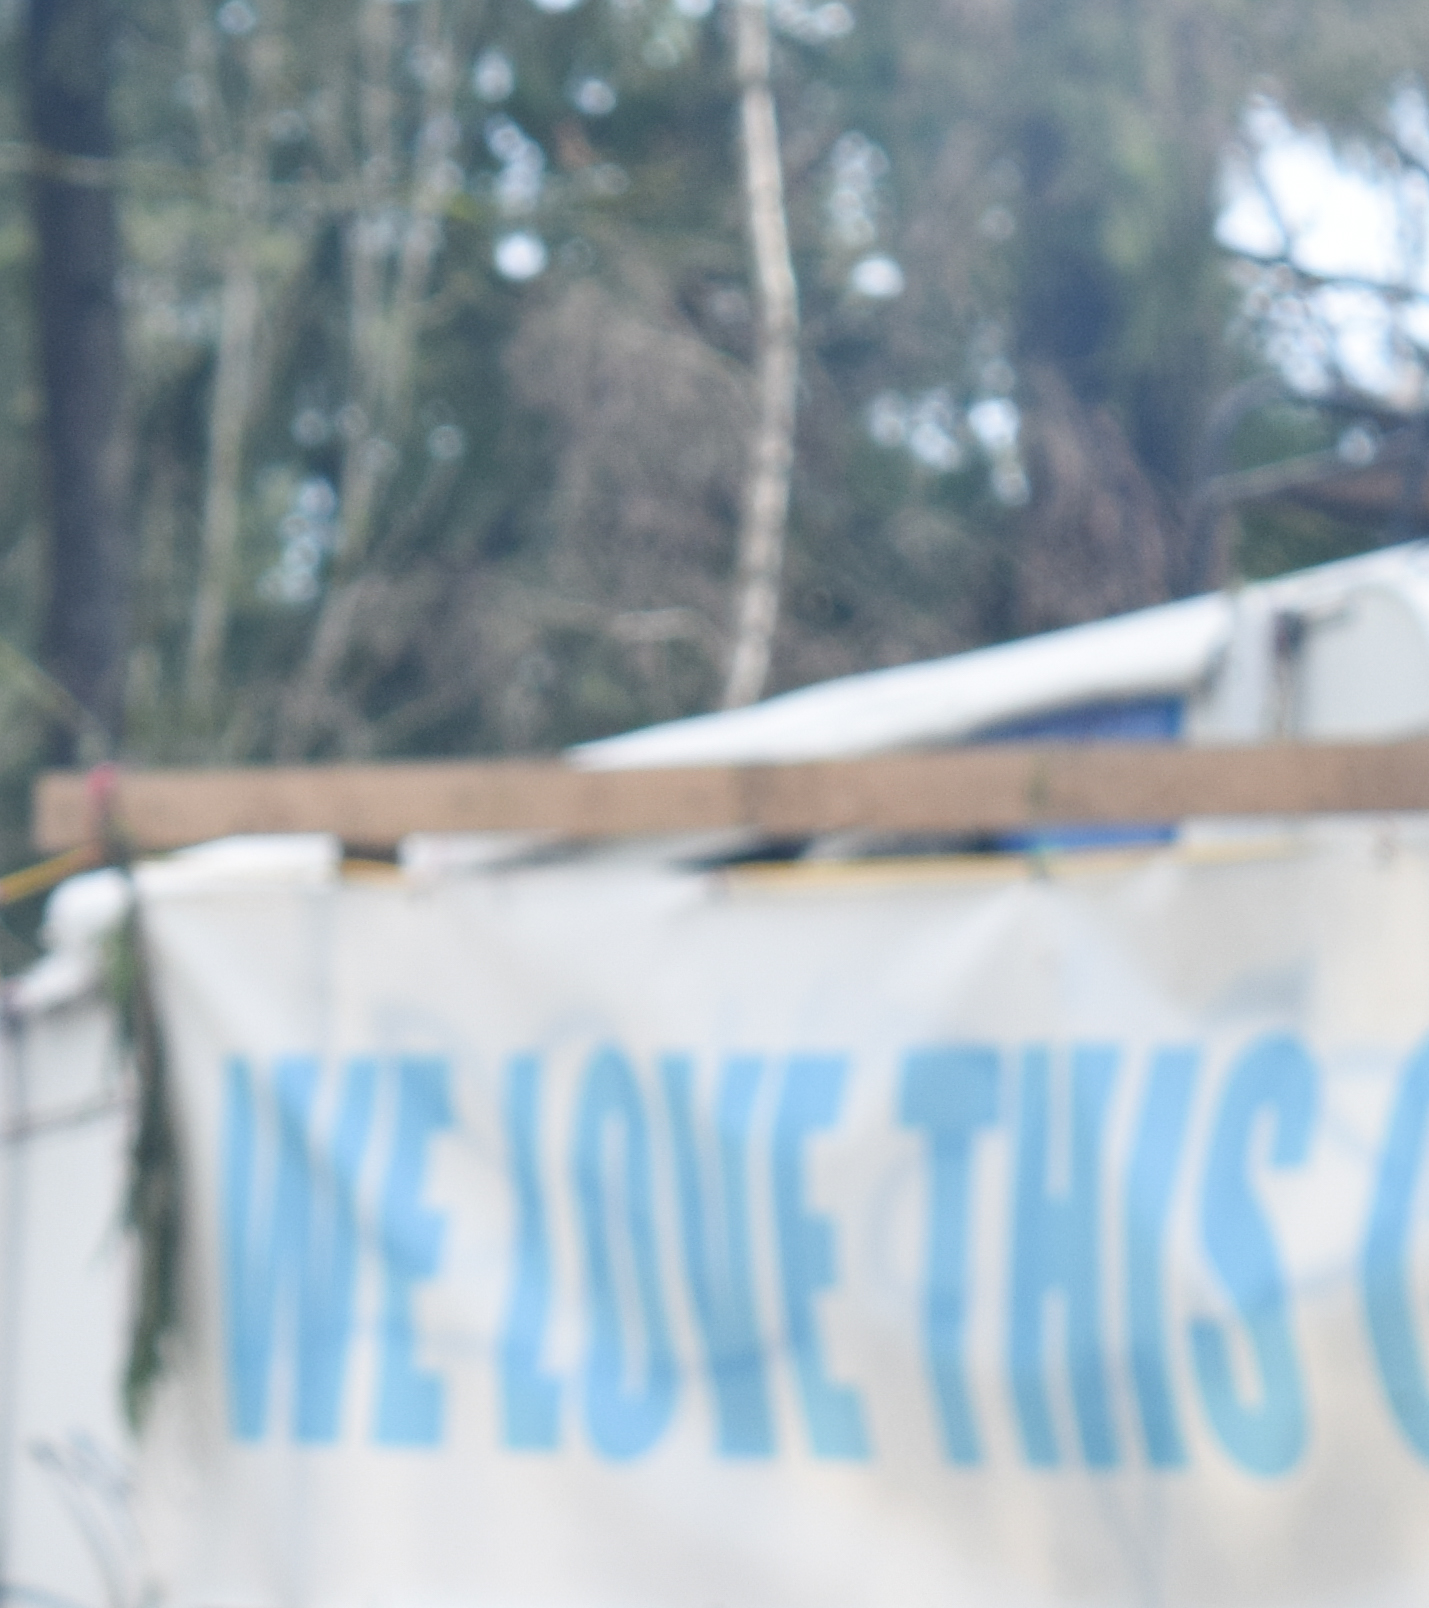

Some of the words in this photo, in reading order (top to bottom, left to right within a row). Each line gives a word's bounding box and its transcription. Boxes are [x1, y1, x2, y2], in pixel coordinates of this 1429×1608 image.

[219, 1050, 456, 1450] WE
[498, 1036, 875, 1464] LOVE
[900, 1034, 1324, 1480] THIS
